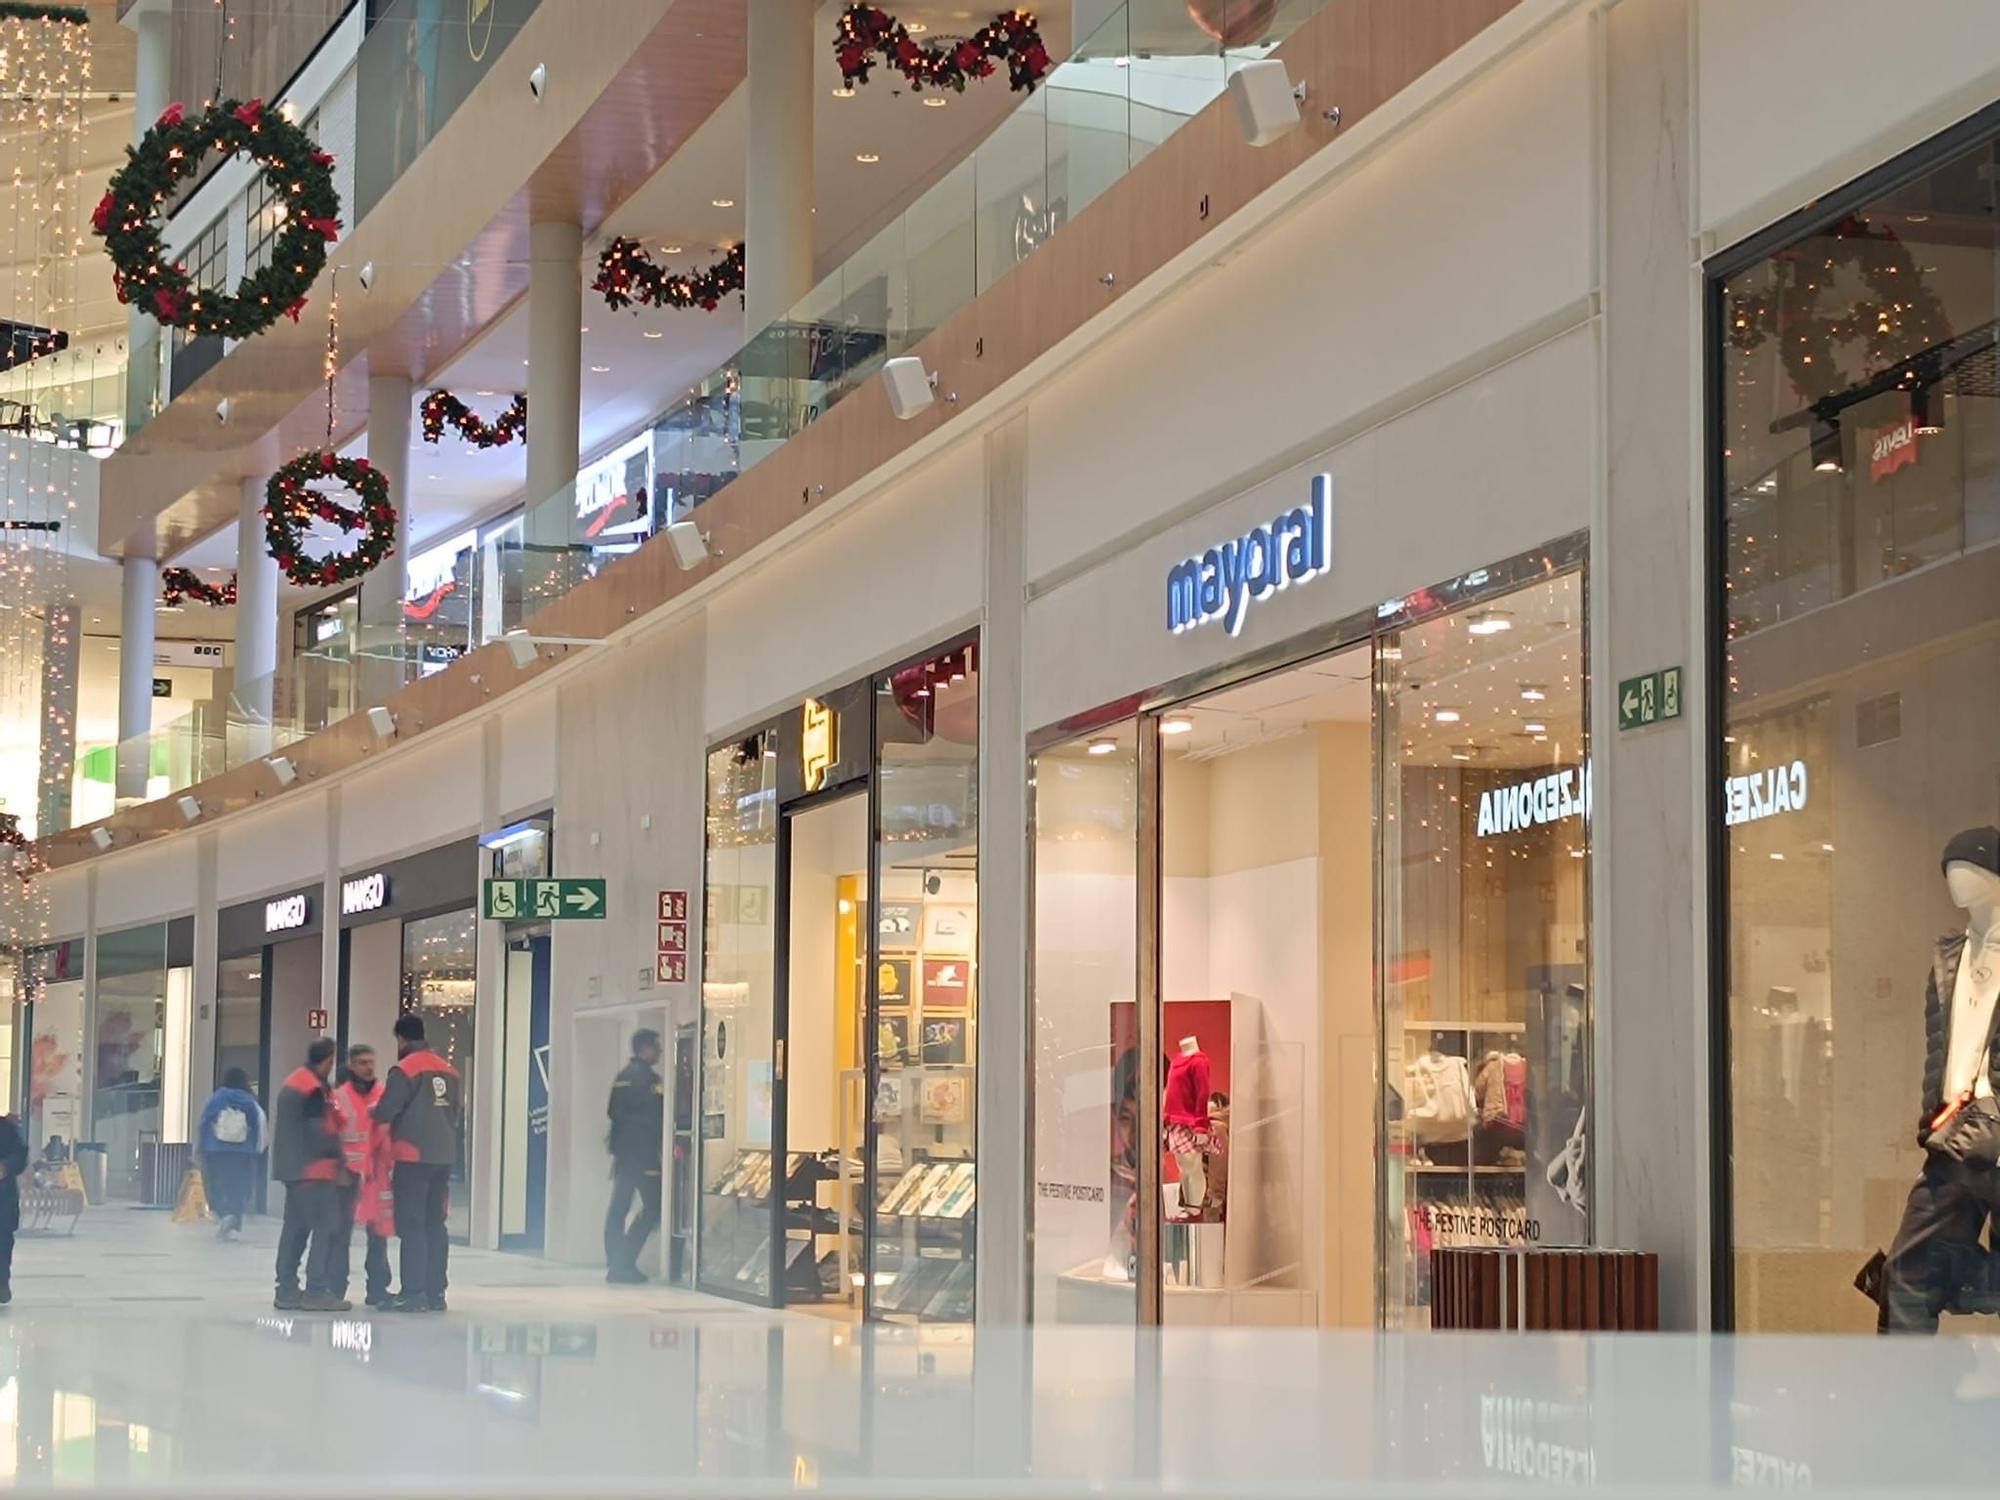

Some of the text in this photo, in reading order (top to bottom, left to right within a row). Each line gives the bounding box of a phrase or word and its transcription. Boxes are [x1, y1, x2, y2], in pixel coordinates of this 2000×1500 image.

[1167, 473, 1331, 637] mayoral
[265, 894, 307, 933] MANGO
[343, 872, 386, 915] MANGO
[1414, 1210, 1541, 1241] THE FESTIVE POSTCARD
